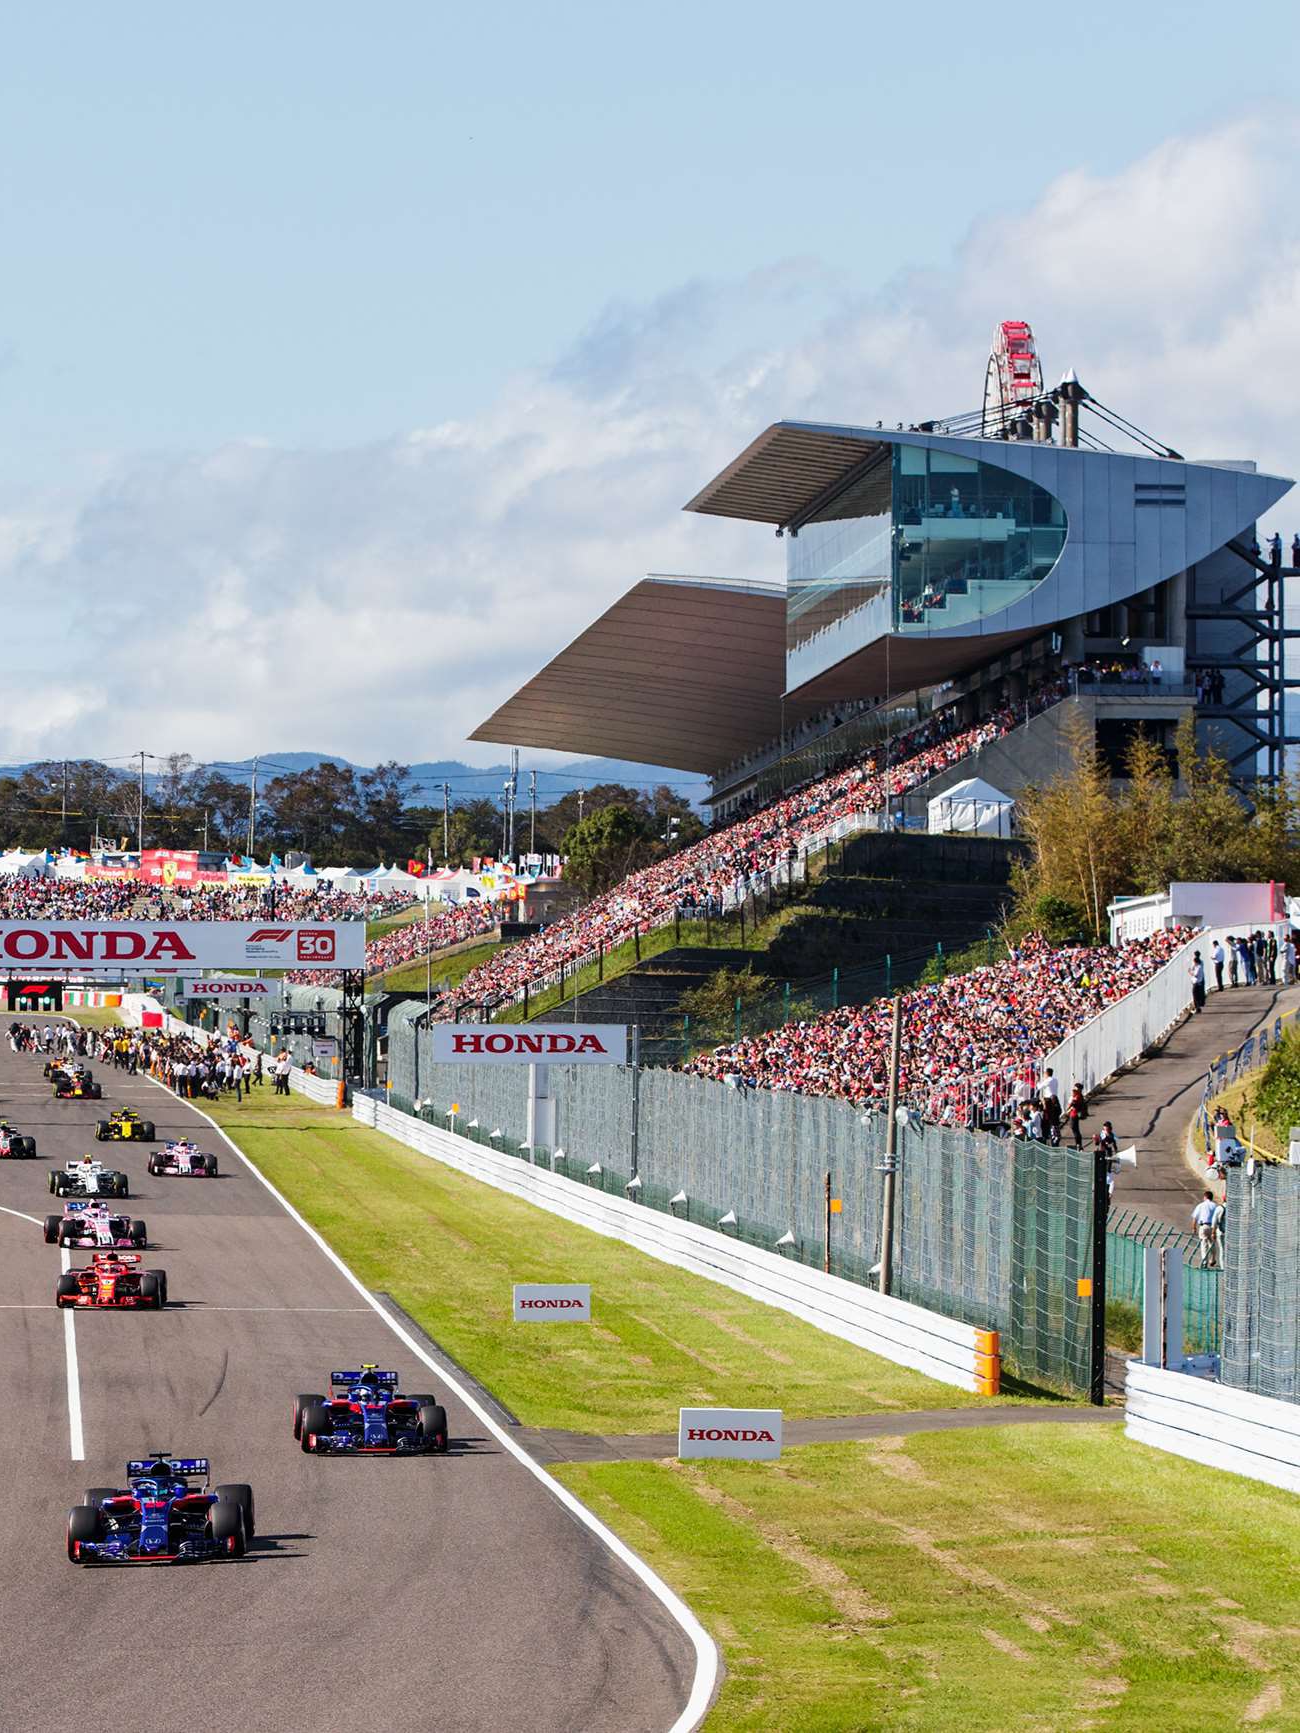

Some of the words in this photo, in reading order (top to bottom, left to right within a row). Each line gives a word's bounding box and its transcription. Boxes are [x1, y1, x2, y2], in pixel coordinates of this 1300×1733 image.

[299, 936, 333, 955] 30
[192, 983, 268, 993] HONDA
[452, 1034, 607, 1055] HONDA
[519, 1299, 584, 1308] HONDA
[687, 1429, 775, 1442] HONDA
